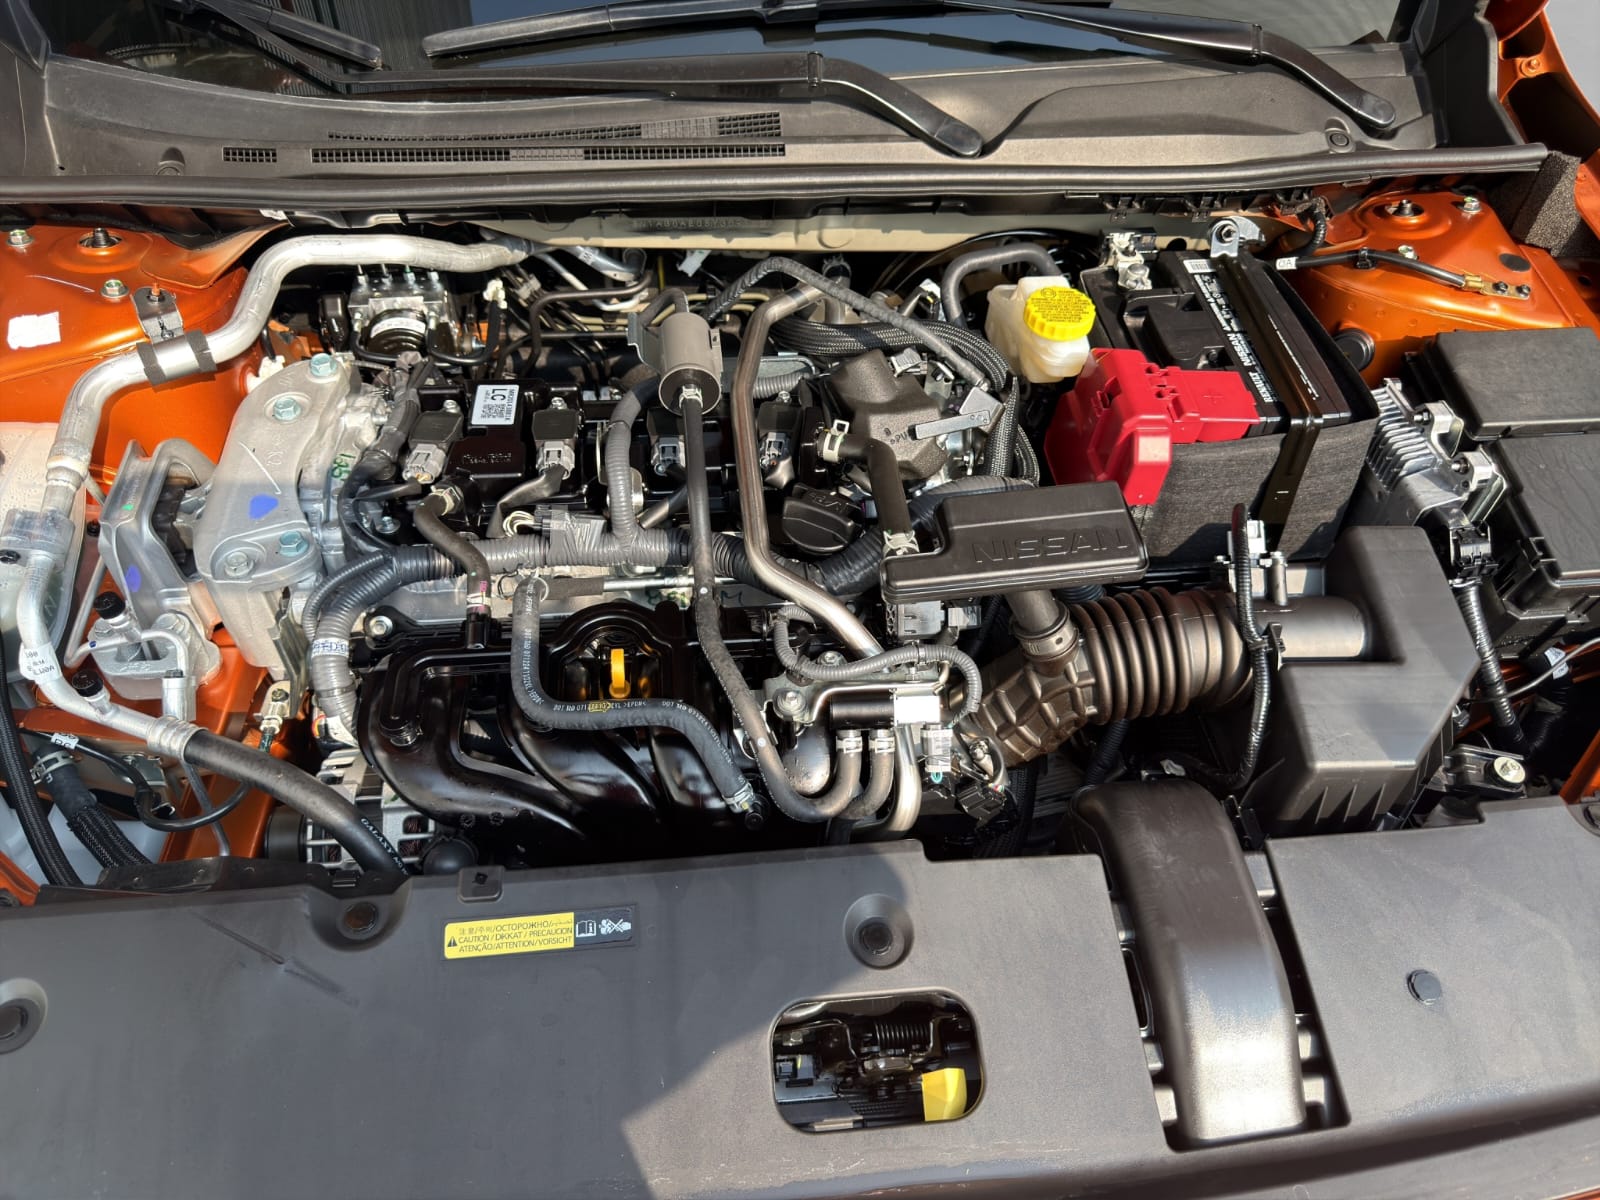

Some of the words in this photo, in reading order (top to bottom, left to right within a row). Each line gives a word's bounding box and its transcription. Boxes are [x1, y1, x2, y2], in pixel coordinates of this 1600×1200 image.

[1227, 333, 1253, 367] NISSAN
[1249, 371, 1274, 402] RENAULT
[971, 528, 1128, 563] NISSAN
[458, 934, 490, 944] CAUTION
